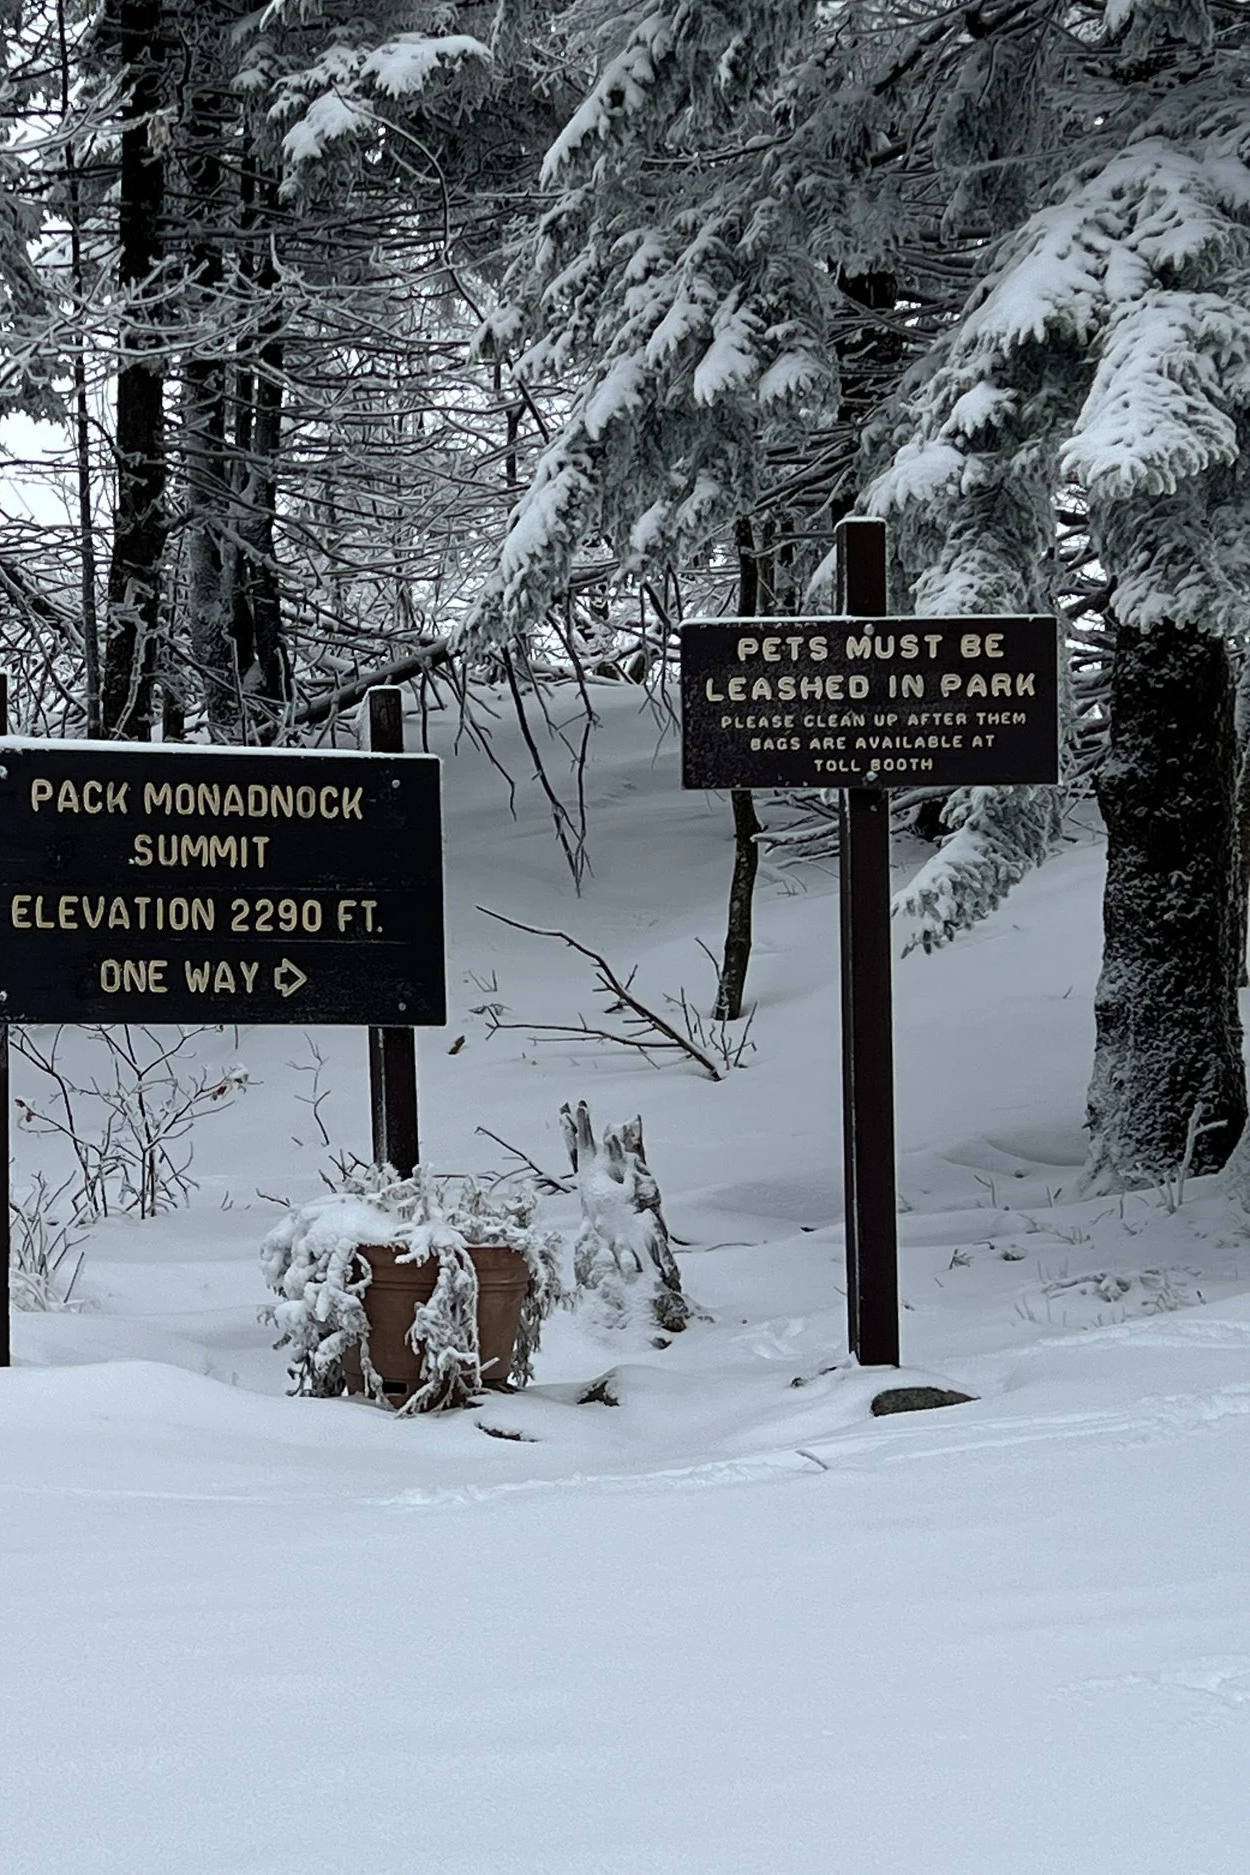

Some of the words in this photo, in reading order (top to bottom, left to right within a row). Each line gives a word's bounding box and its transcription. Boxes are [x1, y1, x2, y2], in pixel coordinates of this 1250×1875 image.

[737, 636, 828, 662] PETS
[846, 634, 943, 660] MUST
[960, 633, 1005, 658] BE
[705, 674, 870, 702] LEASHED
[889, 674, 924, 698] IN
[940, 672, 1036, 698] PARK
[720, 714, 795, 729] PLEASE
[804, 713, 866, 728] CLEAN
[873, 713, 898, 727] UP
[907, 712, 967, 727] AFTER
[976, 711, 1027, 725] THEM
[750, 737, 801, 751] BAGS
[809, 736, 847, 749] ARE
[855, 735, 963, 749] AVAILABLE
[971, 734, 996, 748] AT
[813, 759, 861, 772] TOLL
[870, 758, 933, 772] BOOTH
[31, 778, 130, 815] PACK
[144, 782, 363, 821] MONADNOCK
[133, 834, 270, 868] SUMMIT
[11, 894, 215, 931] ELEVATION
[230, 899, 322, 933] 2290
[337, 900, 383, 934] FT.
[100, 959, 168, 994] ONE
[185, 961, 259, 994] WAY
